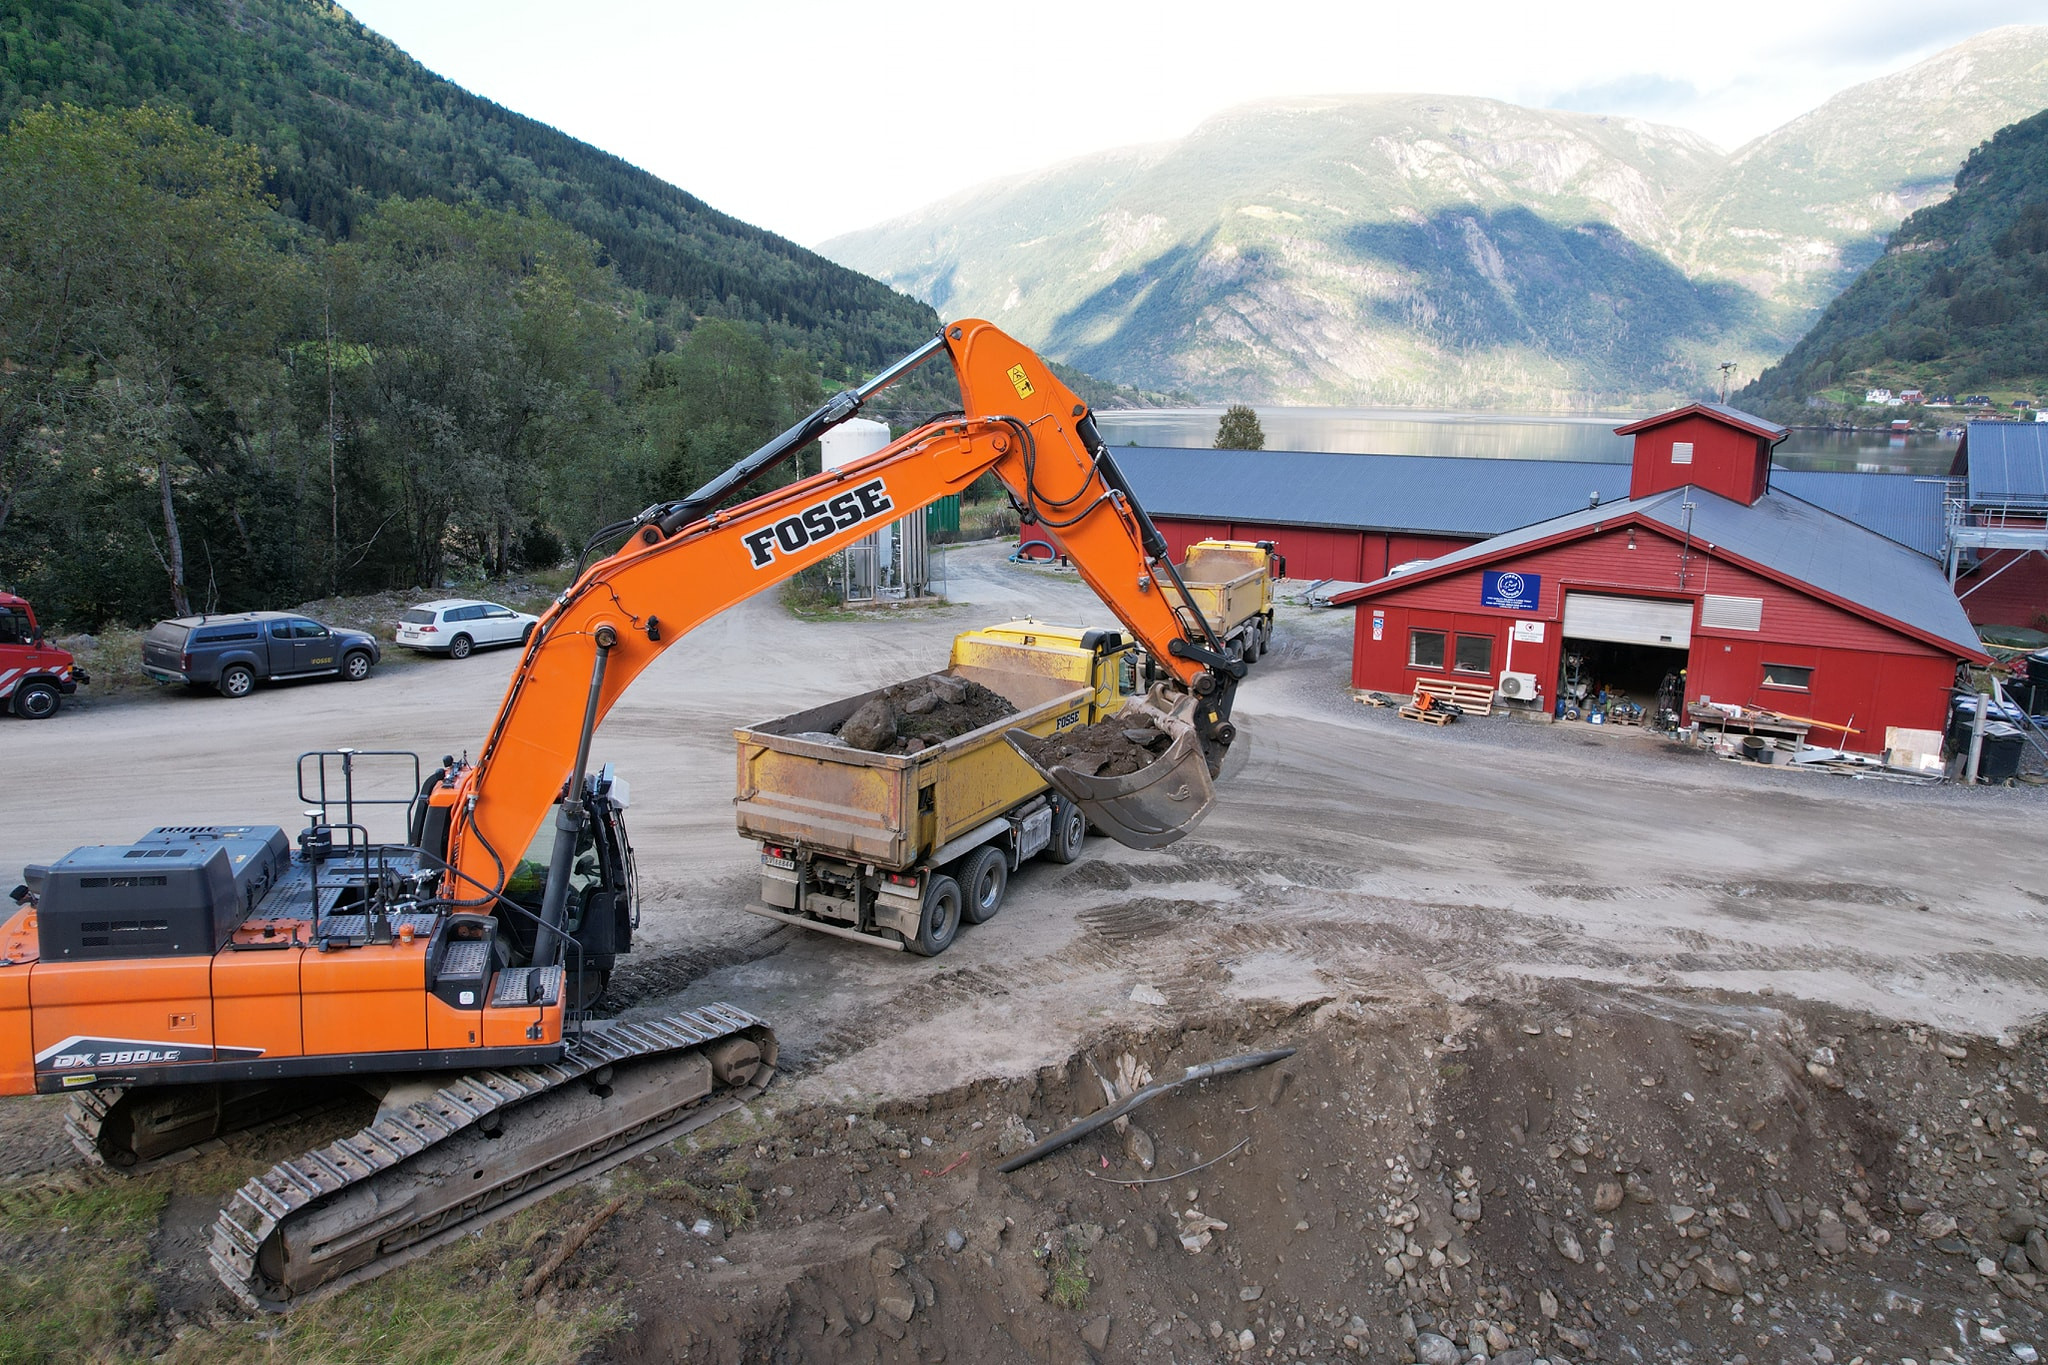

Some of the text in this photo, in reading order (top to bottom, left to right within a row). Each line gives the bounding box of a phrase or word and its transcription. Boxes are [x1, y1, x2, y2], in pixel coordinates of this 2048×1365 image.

[743, 478, 893, 568] FOSSE
[311, 656, 334, 665] FOSSE
[1055, 710, 1080, 730] FOSSE
[53, 1050, 180, 1069] DX 380LC
